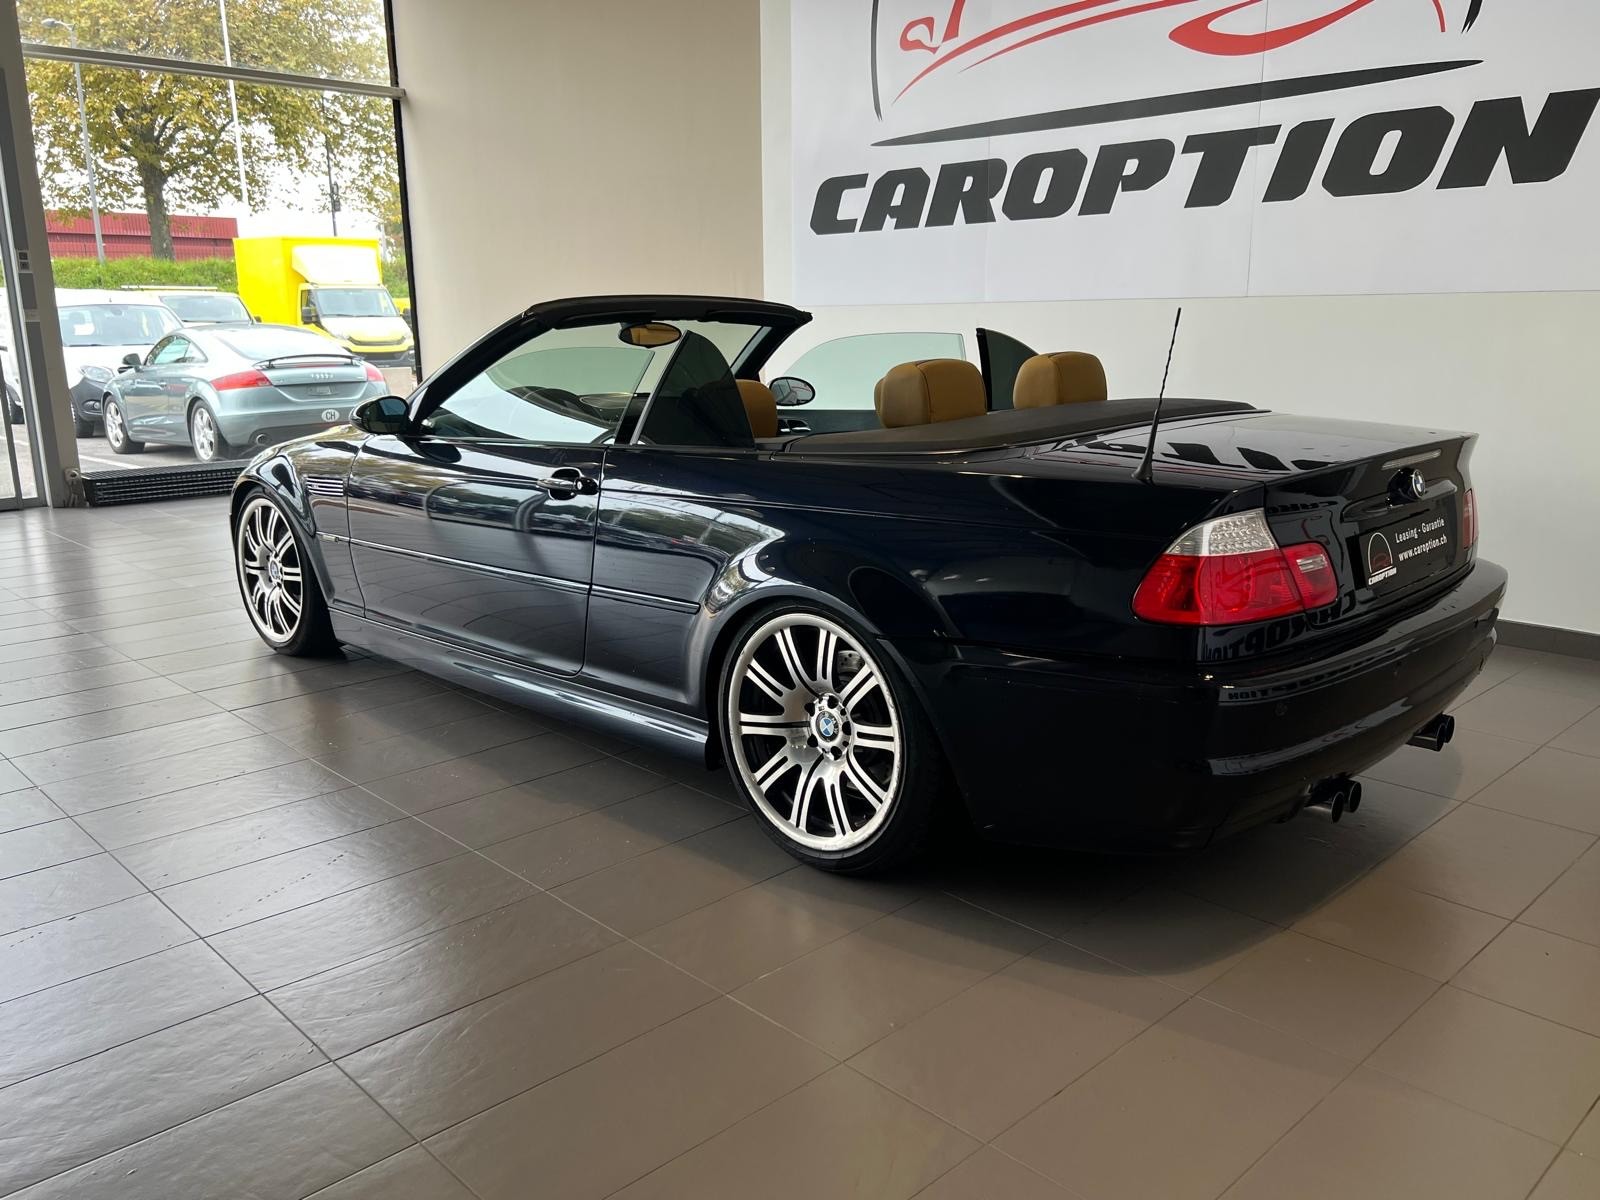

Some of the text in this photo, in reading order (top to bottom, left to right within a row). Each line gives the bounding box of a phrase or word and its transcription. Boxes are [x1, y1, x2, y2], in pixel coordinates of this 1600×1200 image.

[809, 88, 1600, 235] CAROPTION
[326, 411, 336, 420] CH
[1395, 528, 1418, 543] Leasing
[1421, 517, 1445, 533] Garantie
[1398, 533, 1448, 561] www.caroption.ch
